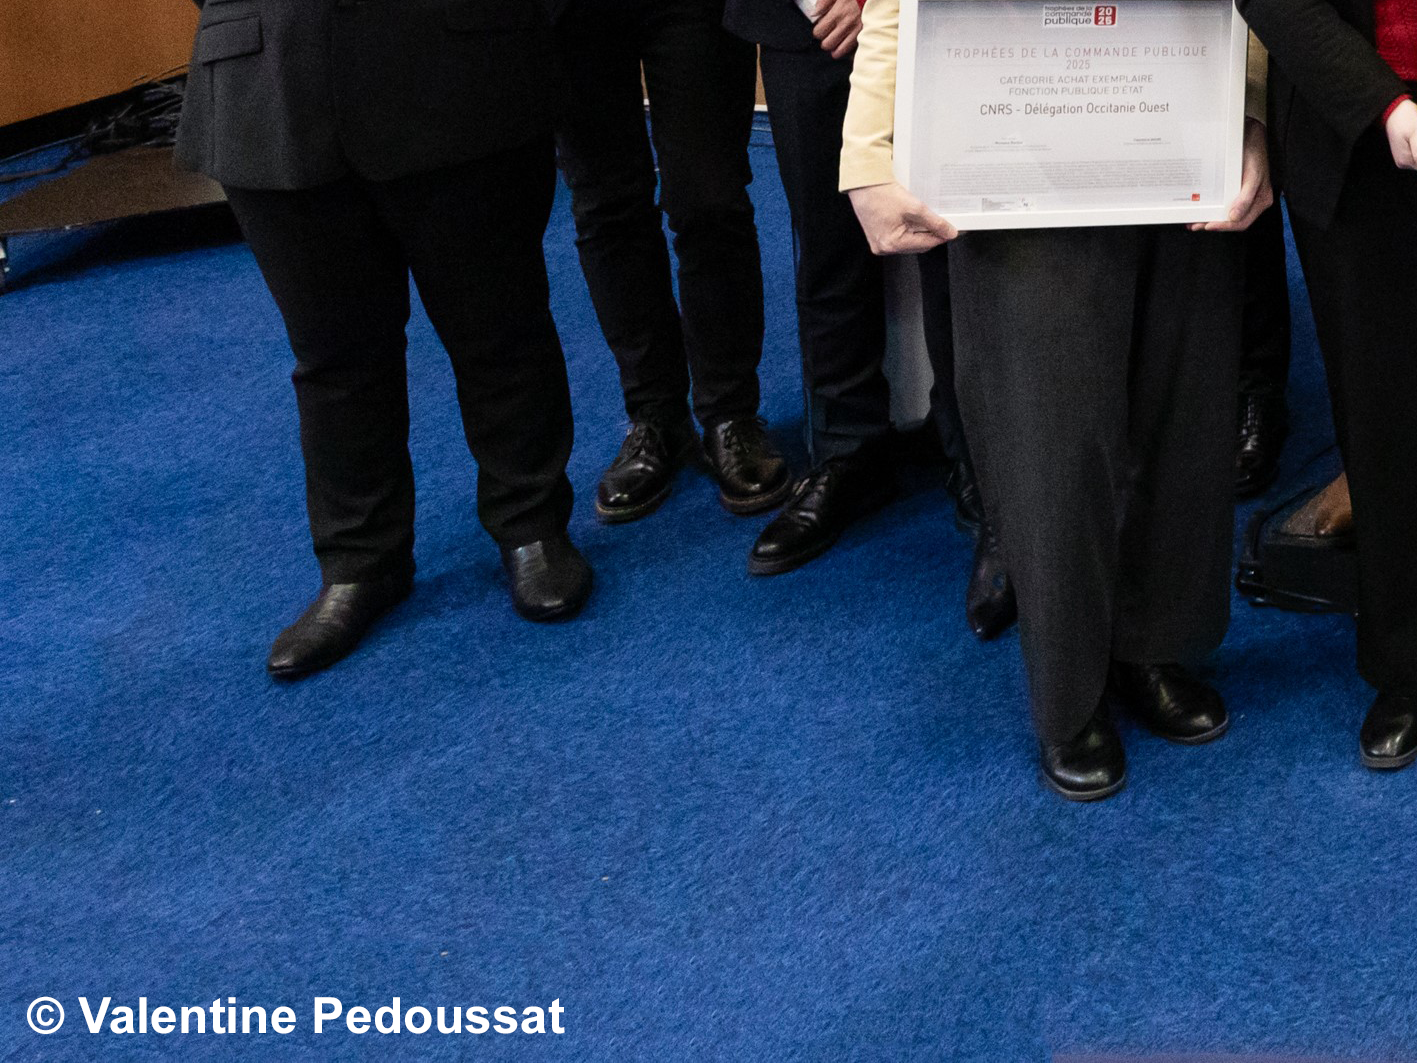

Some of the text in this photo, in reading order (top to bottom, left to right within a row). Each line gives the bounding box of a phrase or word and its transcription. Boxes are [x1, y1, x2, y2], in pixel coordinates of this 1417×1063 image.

[1098, 7, 1113, 16] 20
[1044, 16, 1092, 26] publique
[946, 46, 1208, 58] TROPHÉES DE LA COMMANDE PUBLIQUE
[1066, 59, 1091, 70] 2025
[999, 74, 1154, 85] CATÉGORIE ACHAT EXEMPLAIRE
[1008, 87, 1058, 96] FONCTION
[1060, 87, 1109, 95] PUBLIQUE
[980, 101, 1170, 117] CNRS Délégation Occitanie Ouest
